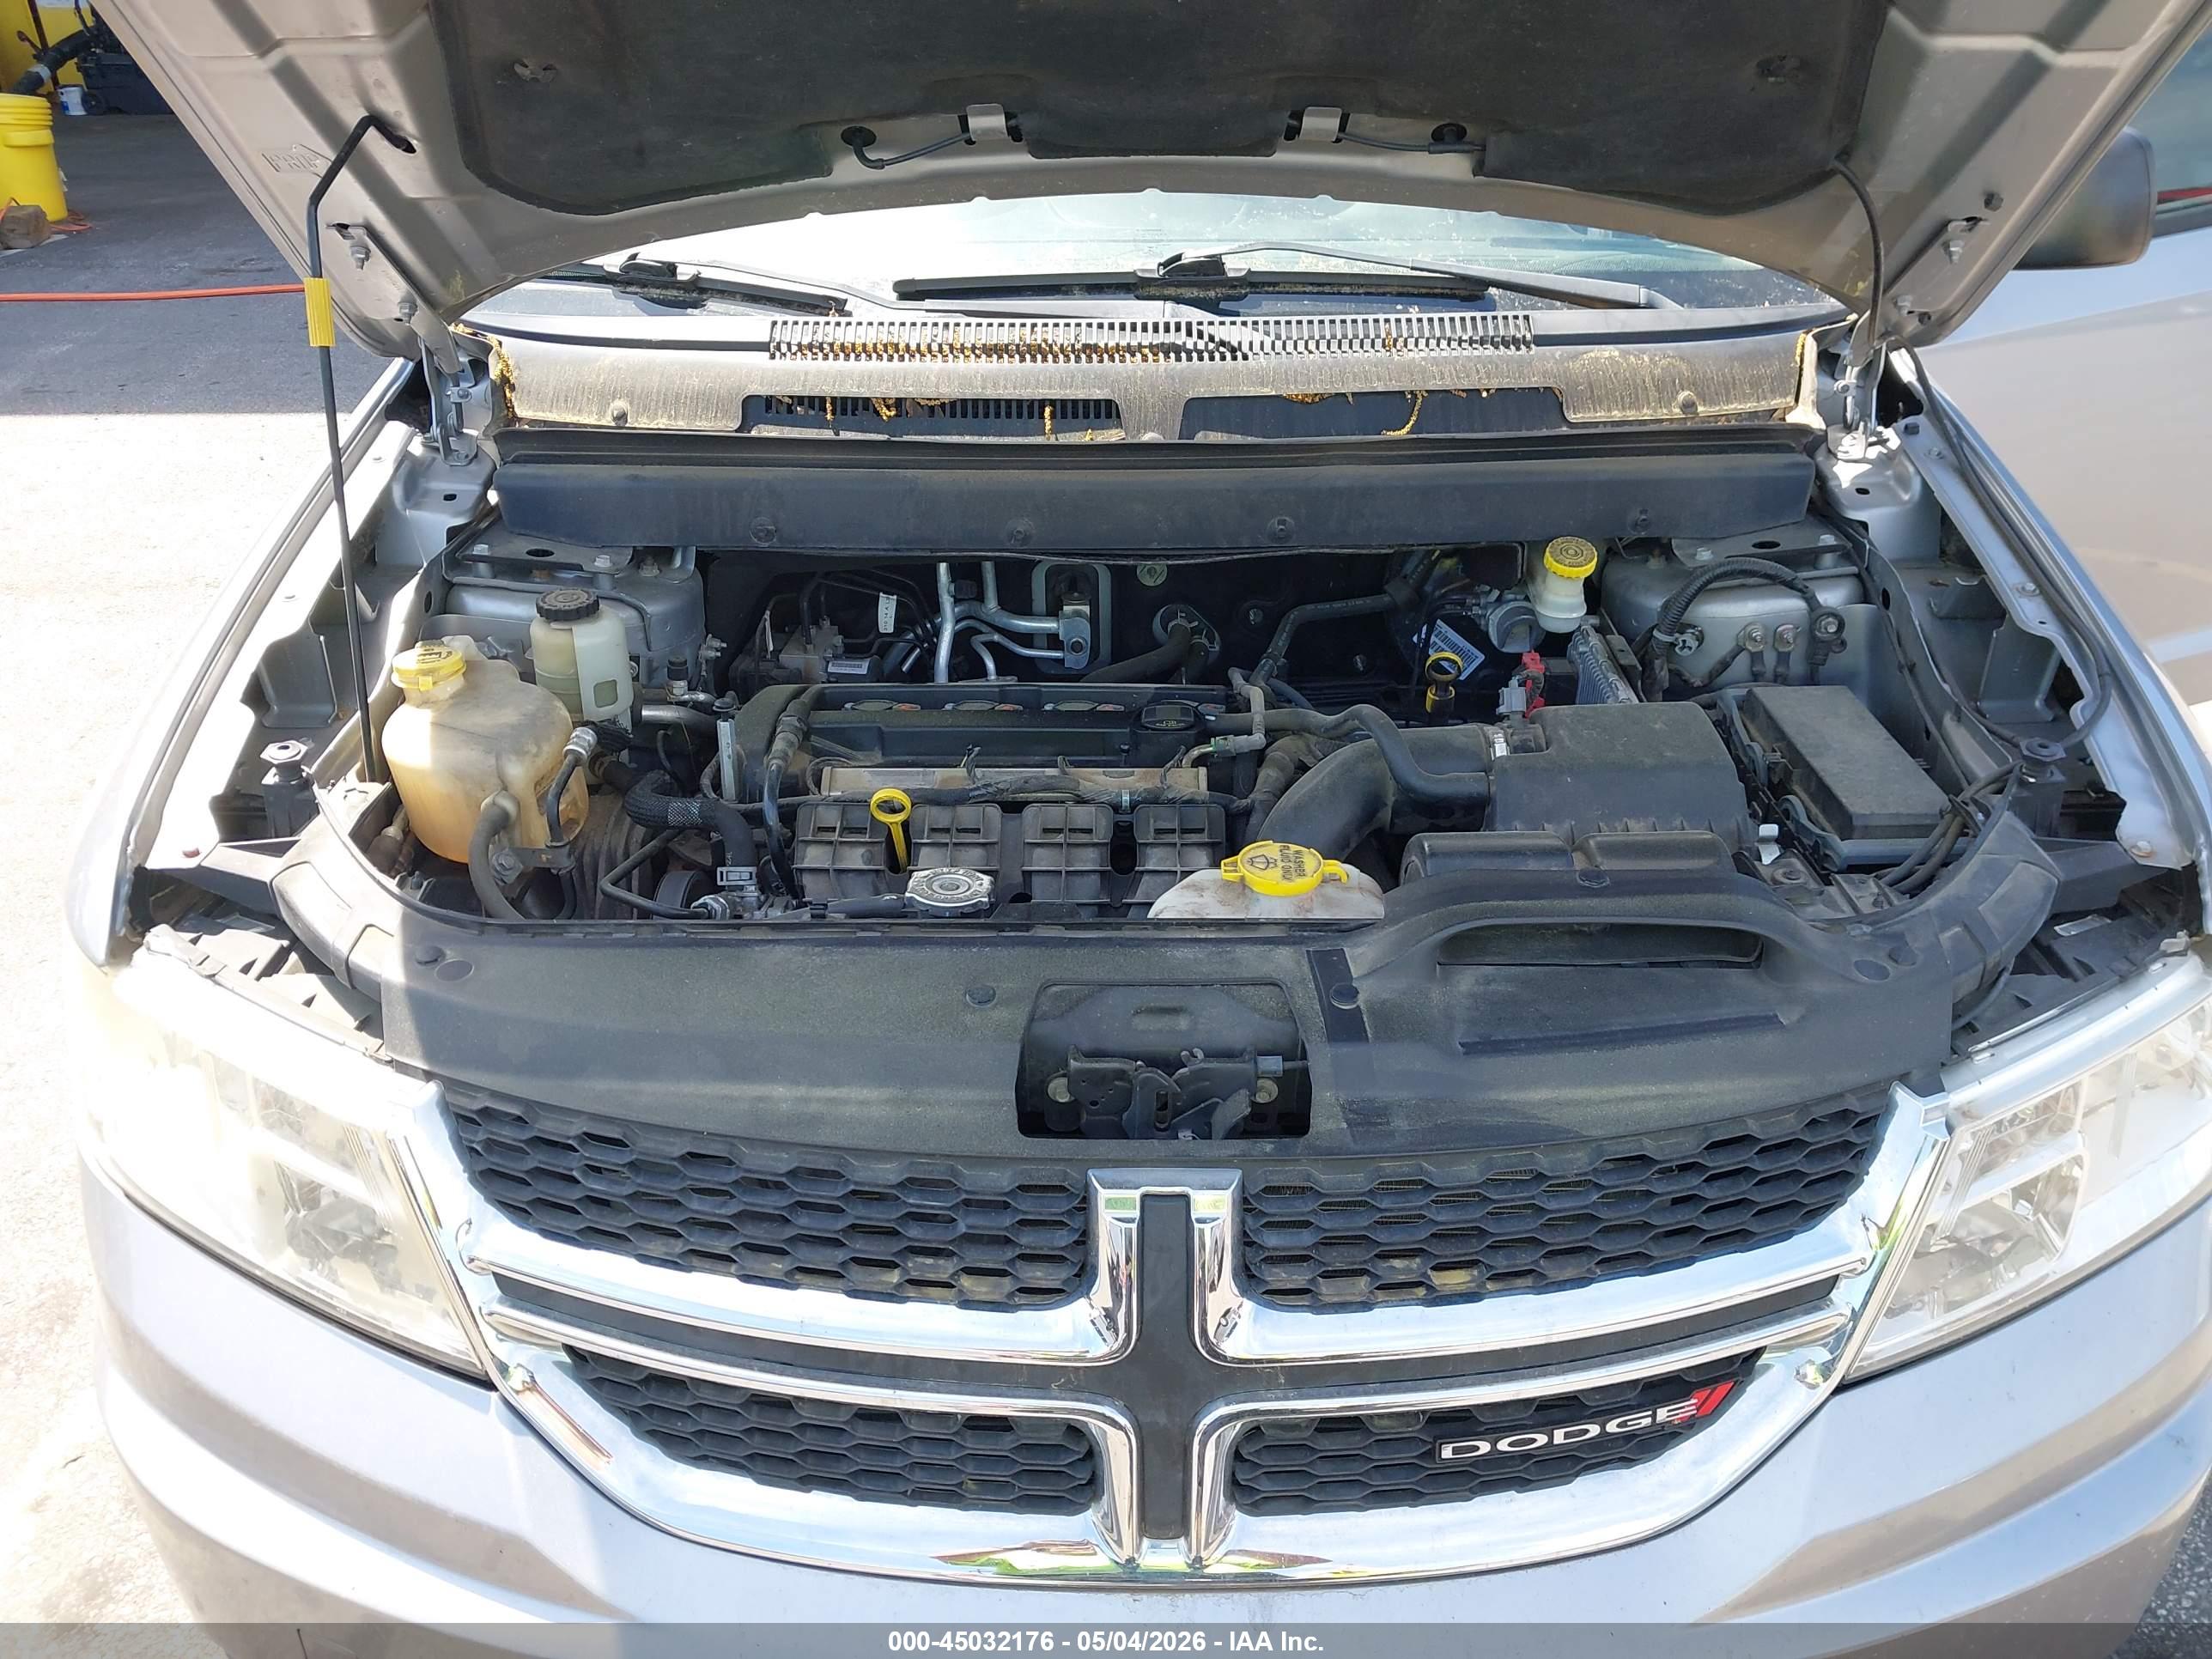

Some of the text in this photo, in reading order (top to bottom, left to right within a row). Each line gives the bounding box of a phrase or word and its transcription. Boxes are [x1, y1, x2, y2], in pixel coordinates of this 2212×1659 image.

[1279, 845, 1293, 883] FLUID ONLY
[1292, 849, 1306, 878] WASHER
[1440, 1397, 1698, 1461] DODGE
